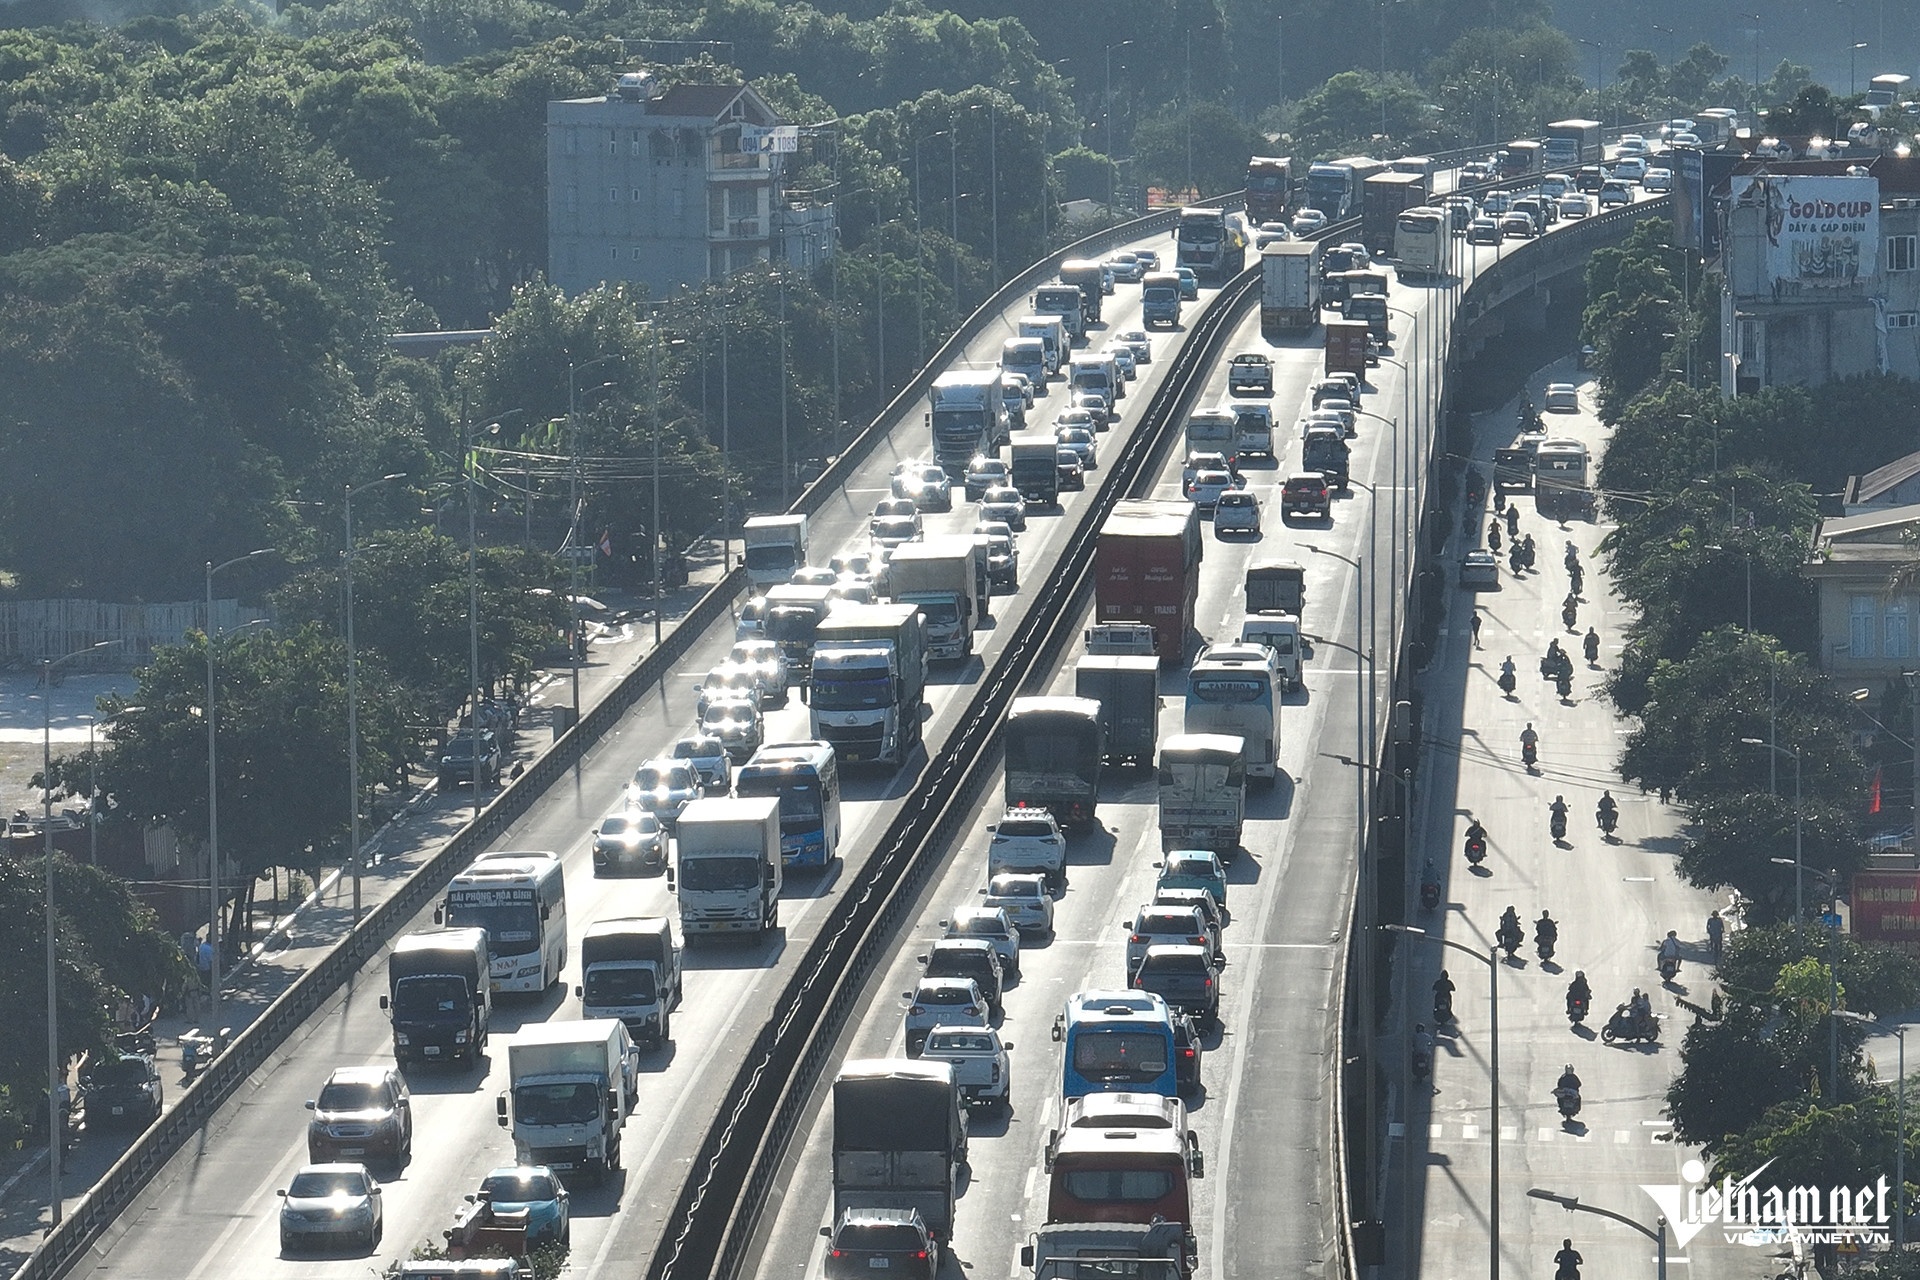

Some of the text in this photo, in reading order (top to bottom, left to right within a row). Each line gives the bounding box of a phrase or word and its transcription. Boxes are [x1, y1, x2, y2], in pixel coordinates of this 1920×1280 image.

[1789, 201, 1872, 219] GOLDCUP
[1810, 223, 1817, 232] &
[496, 958, 518, 970] NAM
